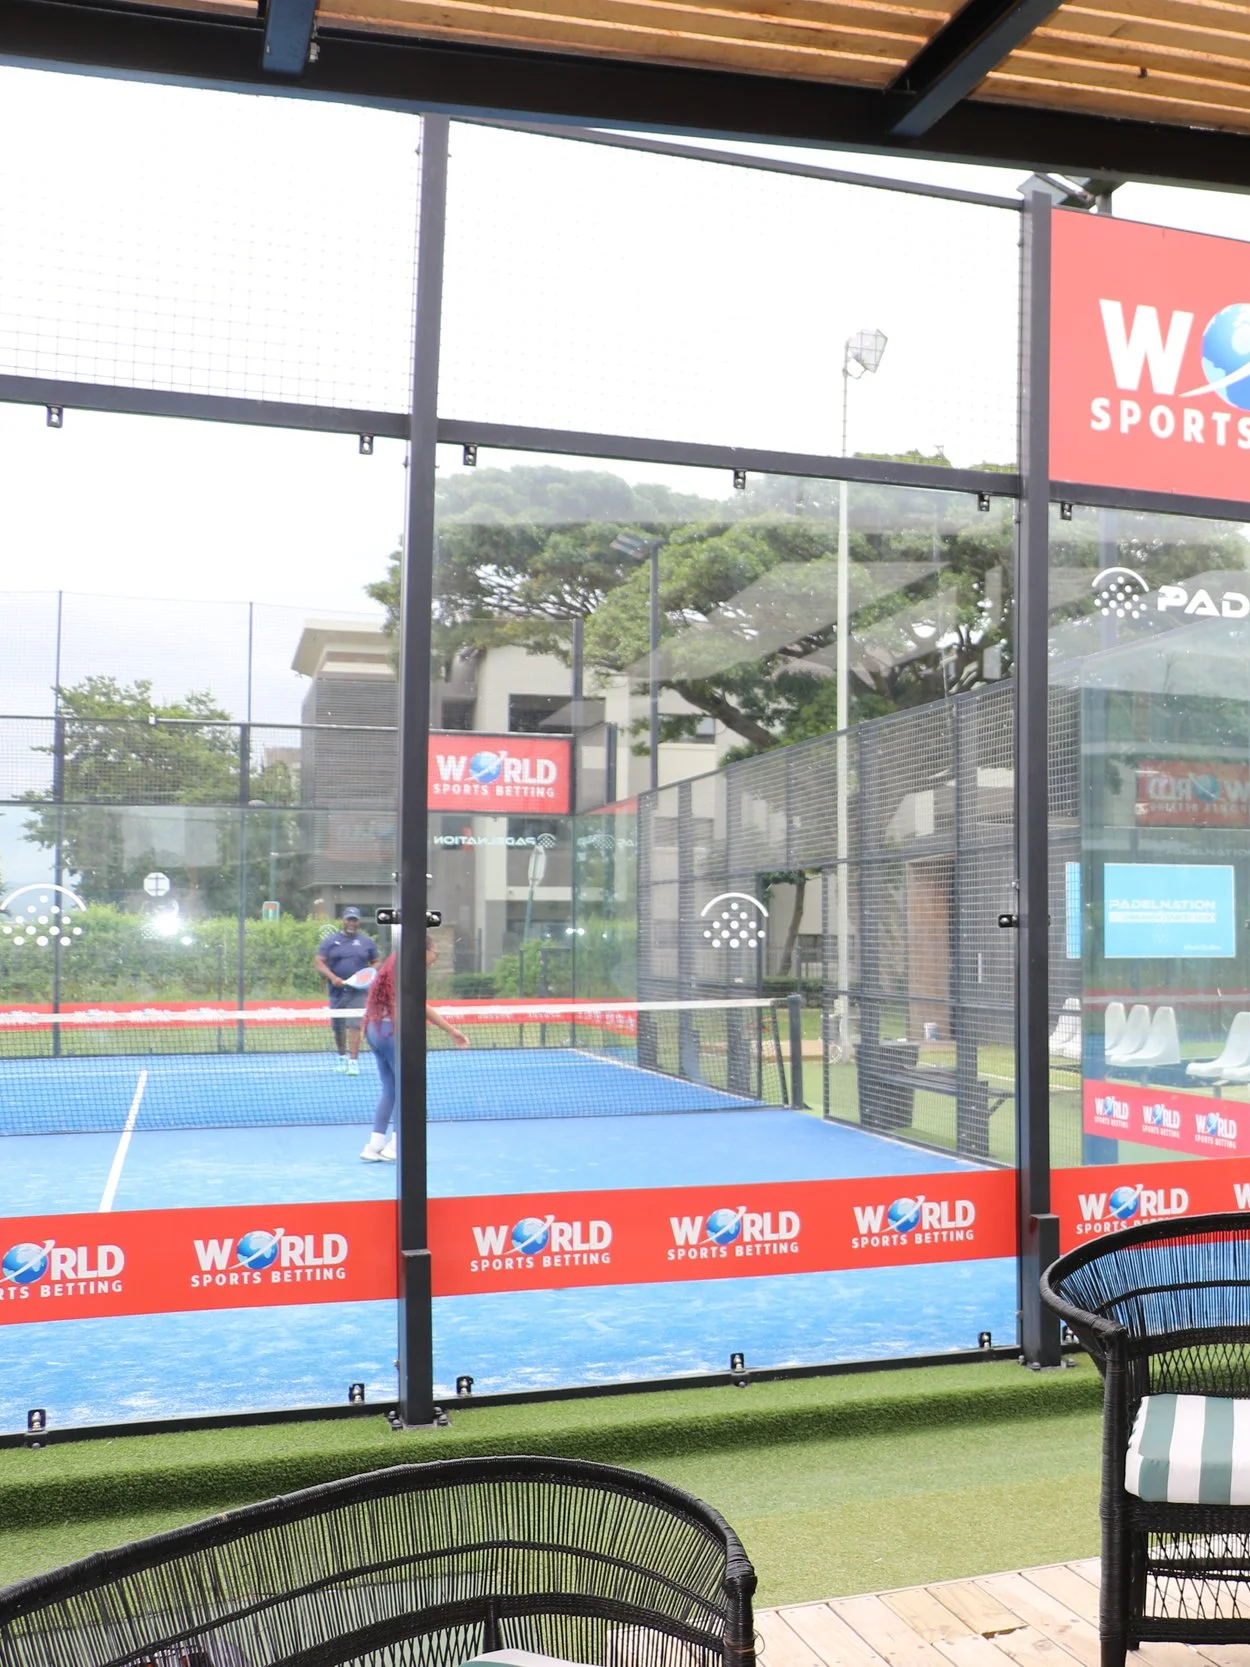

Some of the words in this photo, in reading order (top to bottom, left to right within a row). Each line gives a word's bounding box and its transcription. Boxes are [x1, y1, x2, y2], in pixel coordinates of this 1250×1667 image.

[435, 750, 557, 785] WORLD
[433, 783, 489, 796] SPORTS
[495, 785, 555, 798] BETTING
[1078, 1184, 1189, 1221] WORLD
[853, 1195, 976, 1234] WORLD
[472, 1214, 612, 1256] WORLD
[669, 1206, 800, 1246] WORLD
[1076, 1221, 1127, 1235] SPORTS
[193, 1228, 348, 1271] WORLD
[851, 1235, 908, 1249] SPORTS
[914, 1230, 974, 1244] BETTING
[470, 1257, 534, 1272] SPORTS
[542, 1252, 611, 1267] BETTING
[667, 1246, 728, 1261] SPORTS
[735, 1242, 799, 1257] BETTING
[191, 1272, 262, 1288] SPORTS
[271, 1267, 346, 1283] BETTING
[40, 1280, 123, 1298] BETTING
